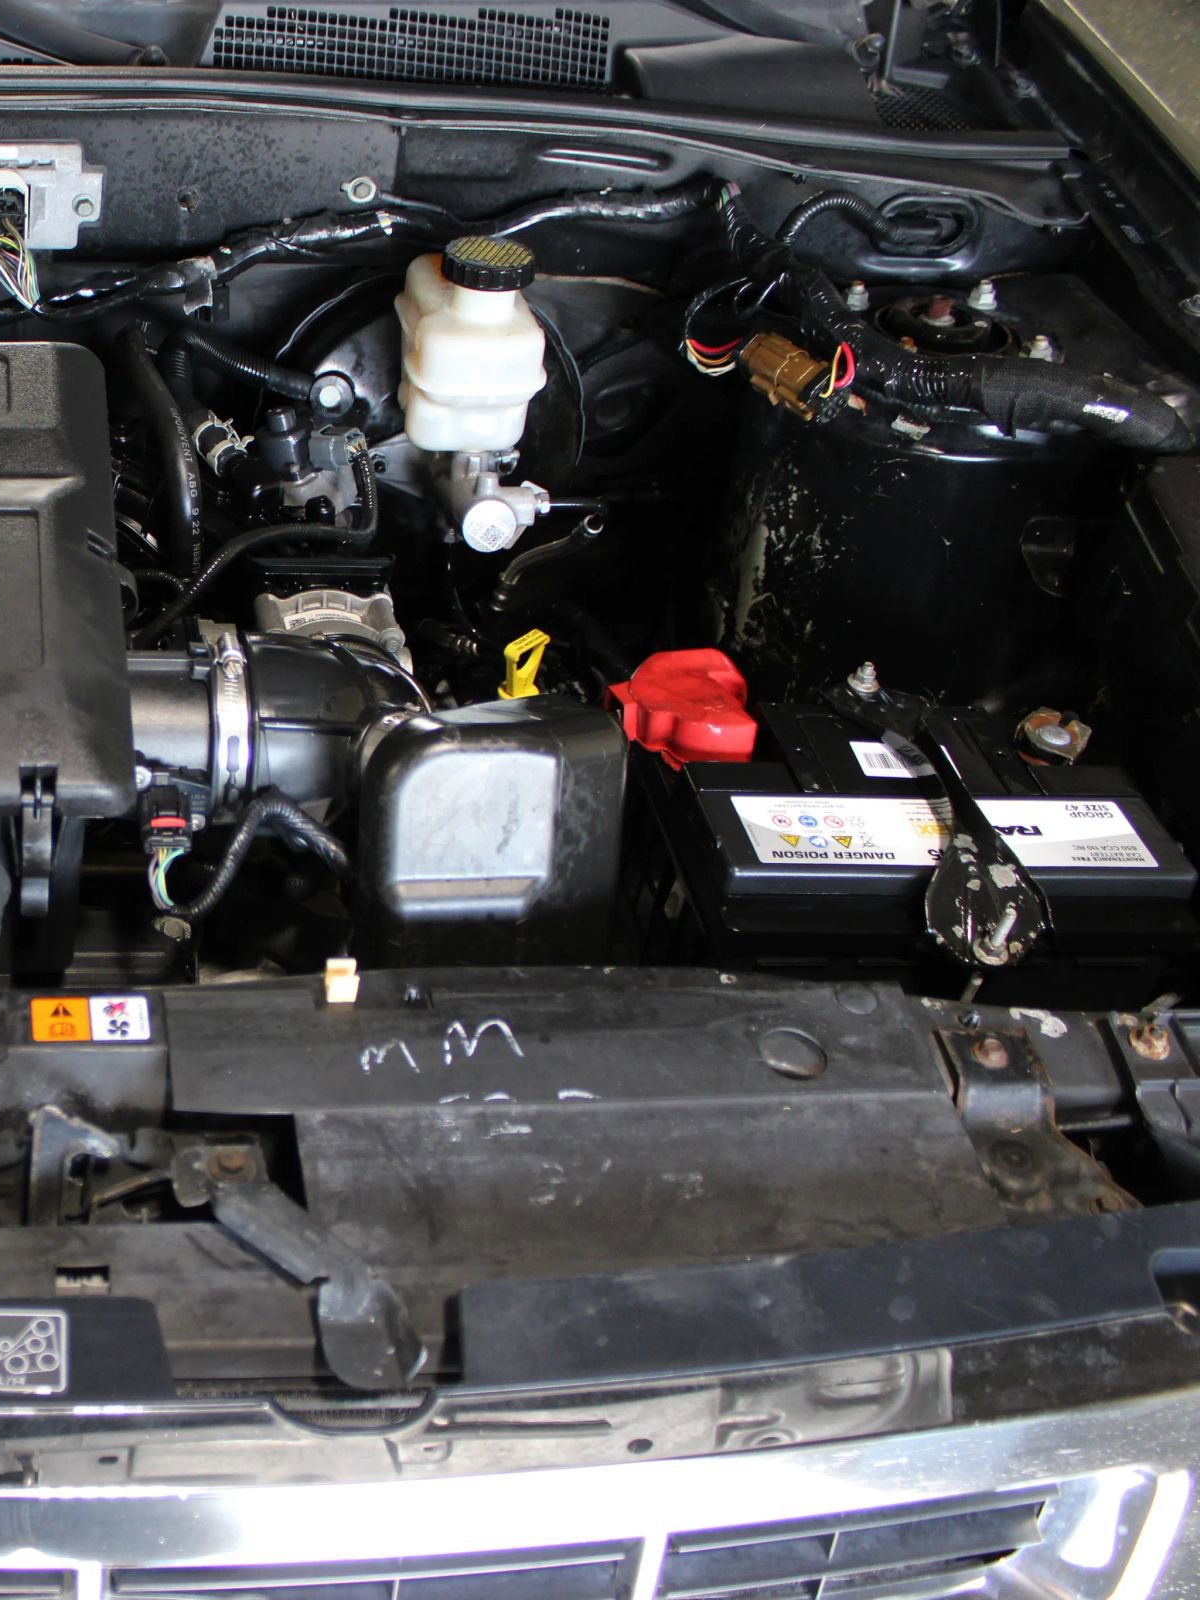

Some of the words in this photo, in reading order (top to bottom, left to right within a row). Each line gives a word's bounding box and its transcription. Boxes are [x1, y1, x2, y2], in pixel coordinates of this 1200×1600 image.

[186, 472, 199, 498] ABG
[191, 507, 200, 516] 9
[191, 521, 201, 536] 22
[1069, 811, 1114, 819] GROUP
[990, 825, 1043, 837] RA
[771, 850, 829, 860] POISON
[833, 850, 896, 861] DANGER
